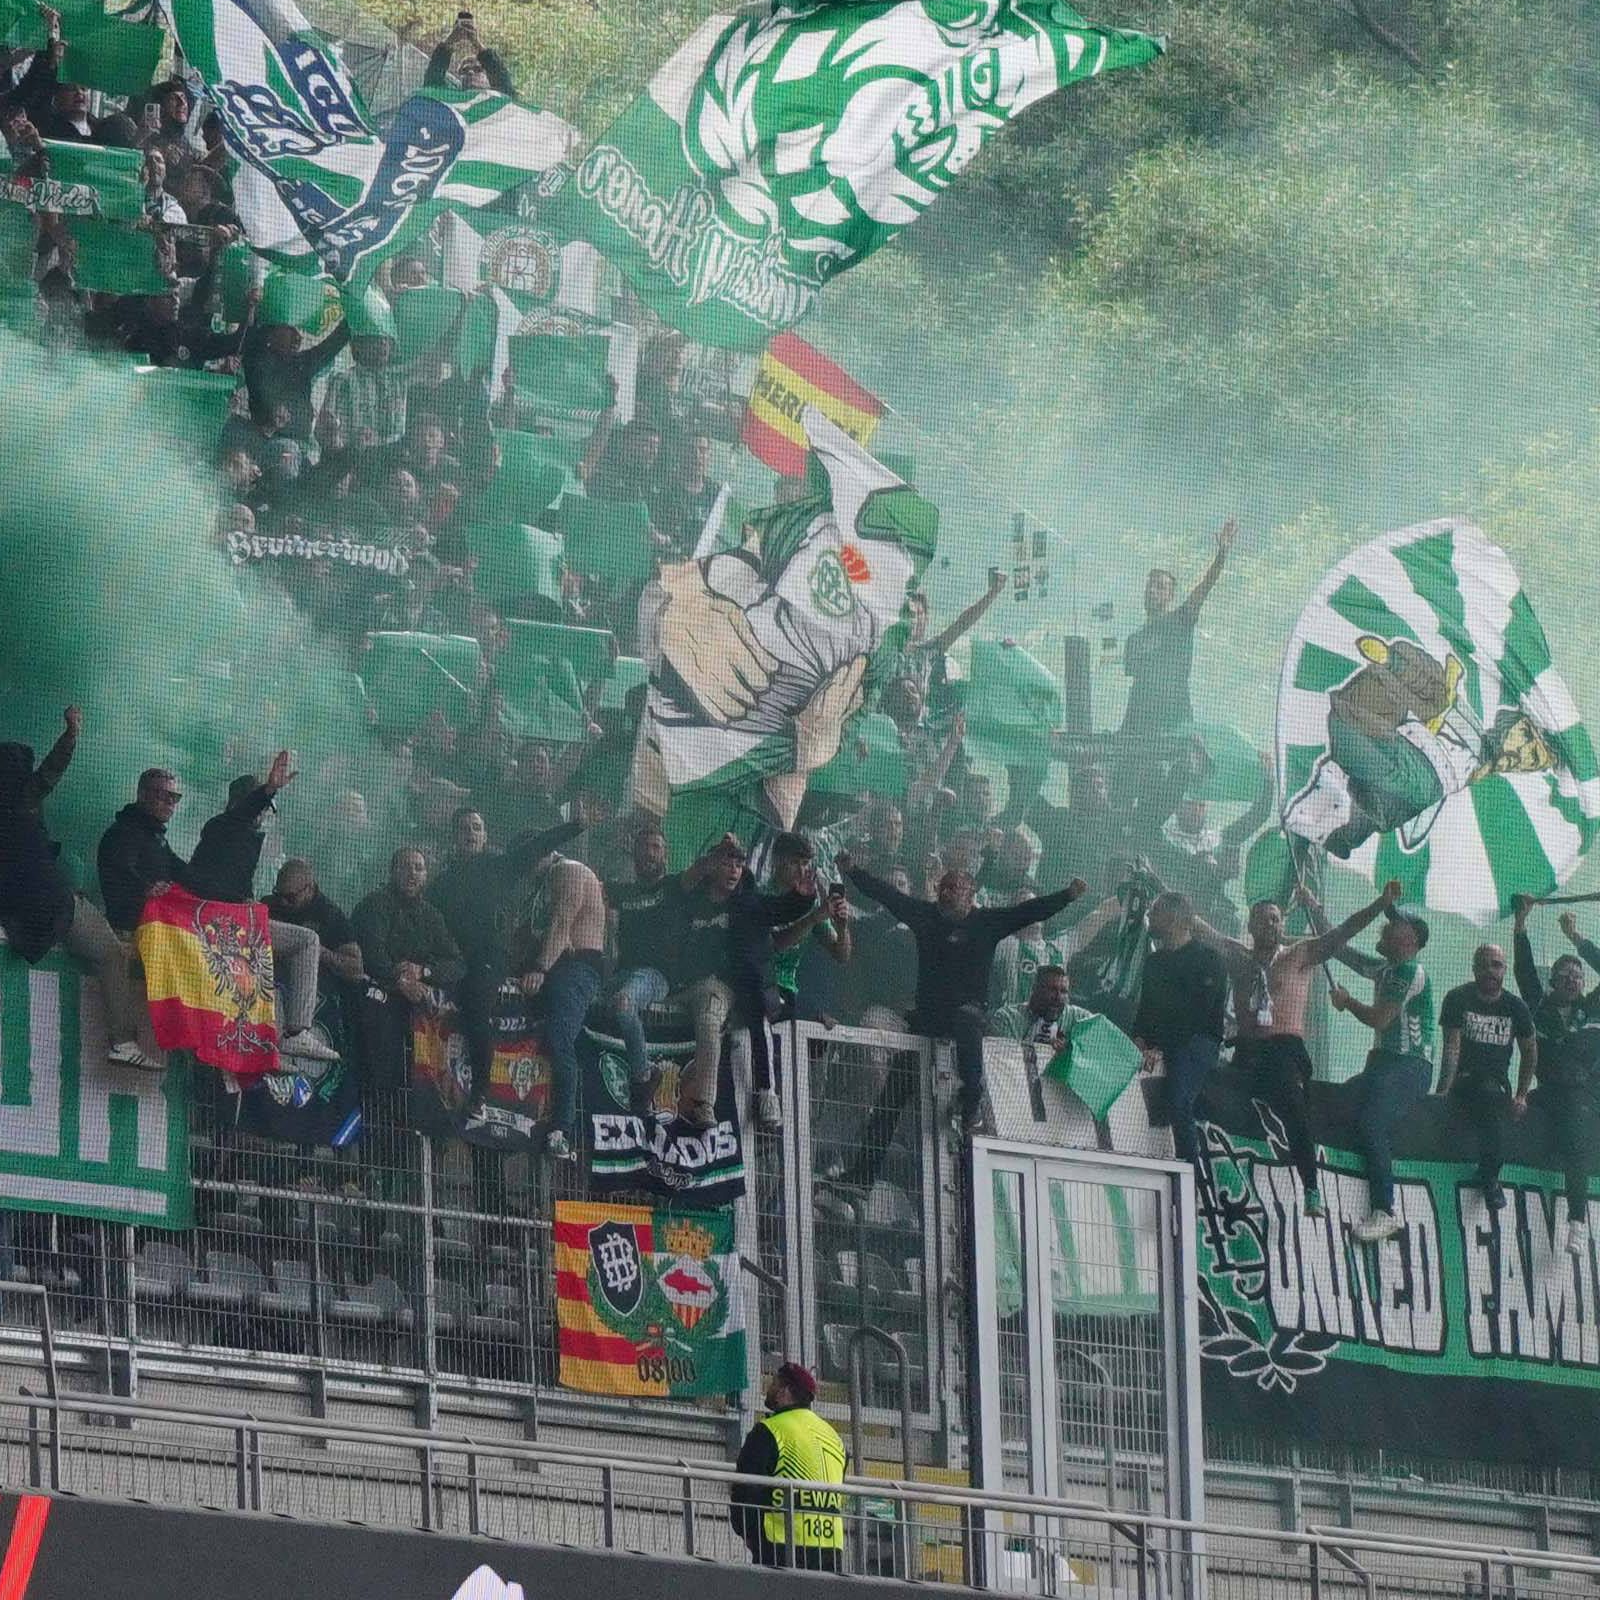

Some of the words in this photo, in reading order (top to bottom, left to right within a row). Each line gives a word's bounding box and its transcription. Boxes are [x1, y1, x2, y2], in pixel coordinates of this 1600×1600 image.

[1253, 1163, 1445, 1355] UNITED
[1458, 1185, 1600, 1366] FAMI
[636, 1356, 697, 1384] 08100
[771, 1487, 842, 1509] STEWA
[803, 1518, 835, 1540] 188
